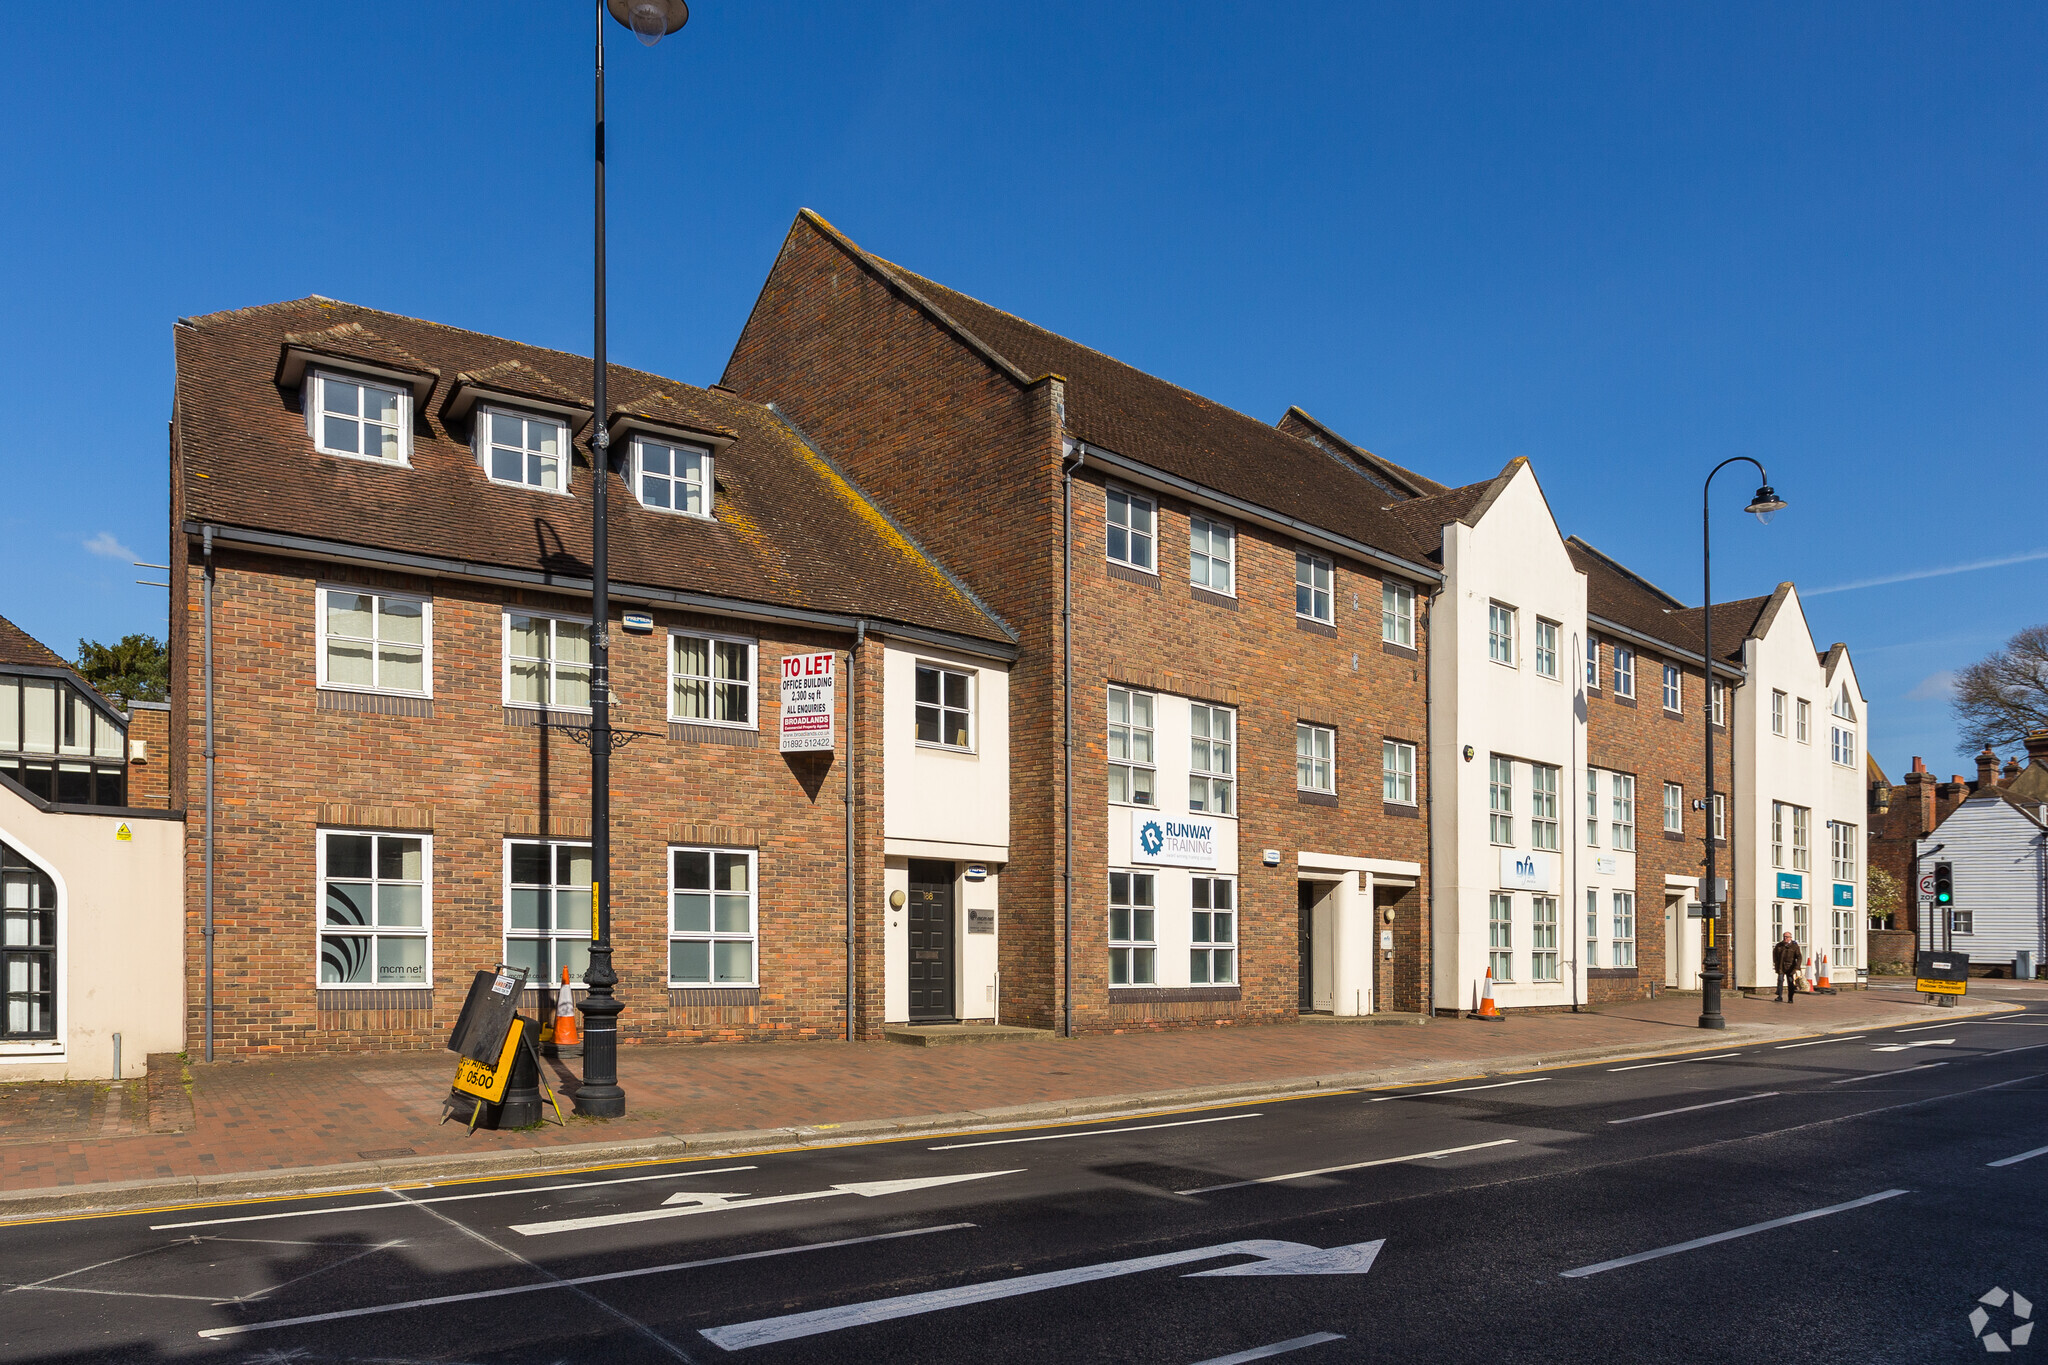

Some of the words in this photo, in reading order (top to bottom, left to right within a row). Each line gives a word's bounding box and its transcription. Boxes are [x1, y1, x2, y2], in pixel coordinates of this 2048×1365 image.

[783, 657, 801, 677] TO
[805, 655, 832, 675] LET
[783, 680, 802, 690] OFFICE
[803, 677, 832, 689] BUILDING
[792, 690, 806, 703] 2,300
[808, 692, 815, 702] sq
[816, 689, 821, 700] ft
[787, 705, 796, 714] ALL
[797, 703, 826, 713] ENQUIRIES
[785, 716, 829, 726] BROADLANDS
[783, 740, 802, 749] 01892
[804, 738, 830, 748] 512422
[1166, 822, 1212, 840] RUNWAY
[1166, 838, 1212, 854] TRAINING
[380, 966, 404, 974] mcm
[406, 965, 422, 974] net
[466, 1071, 494, 1089] 05:00
